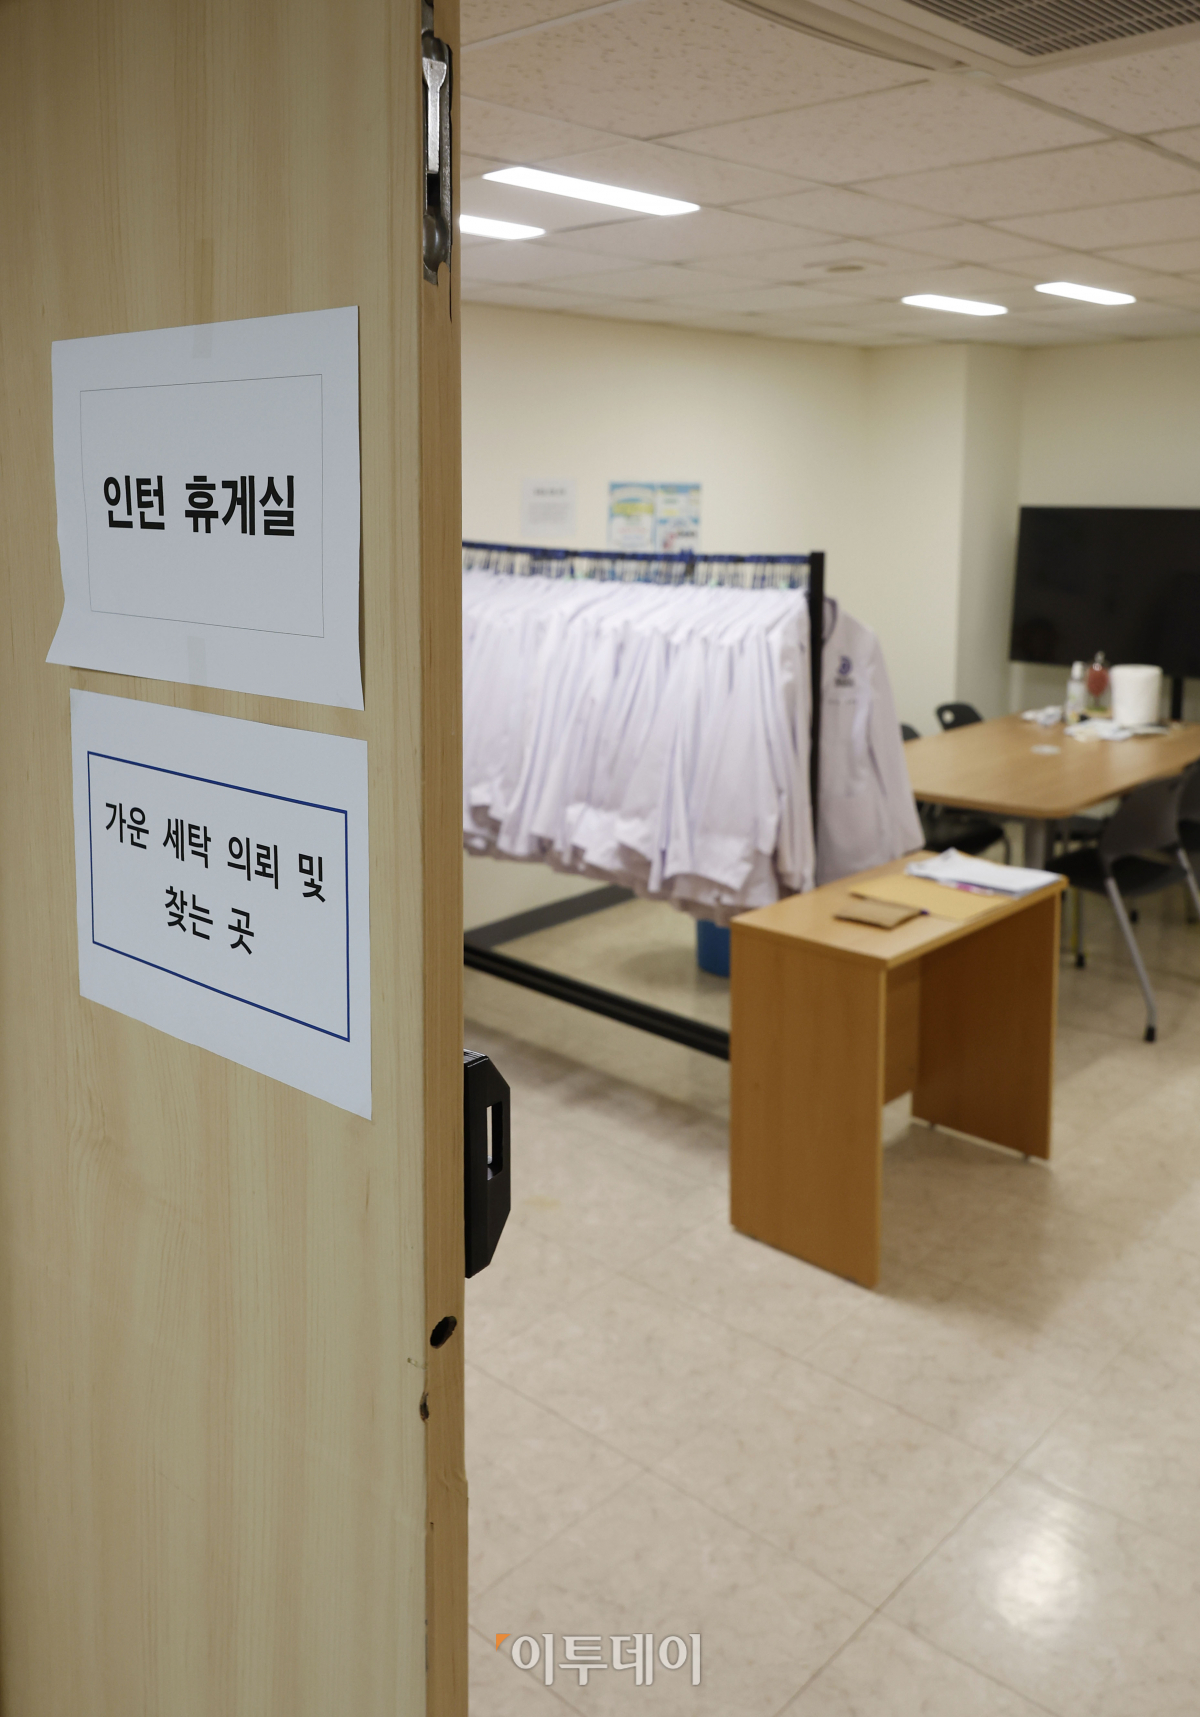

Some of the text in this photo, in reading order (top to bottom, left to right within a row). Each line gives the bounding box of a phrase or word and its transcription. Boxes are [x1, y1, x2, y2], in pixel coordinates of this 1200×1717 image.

[104, 475, 294, 536] 인턴 휴게실
[106, 803, 325, 902] 가운 세탁 의뢰 및
[165, 886, 254, 954] 찾는 곳
